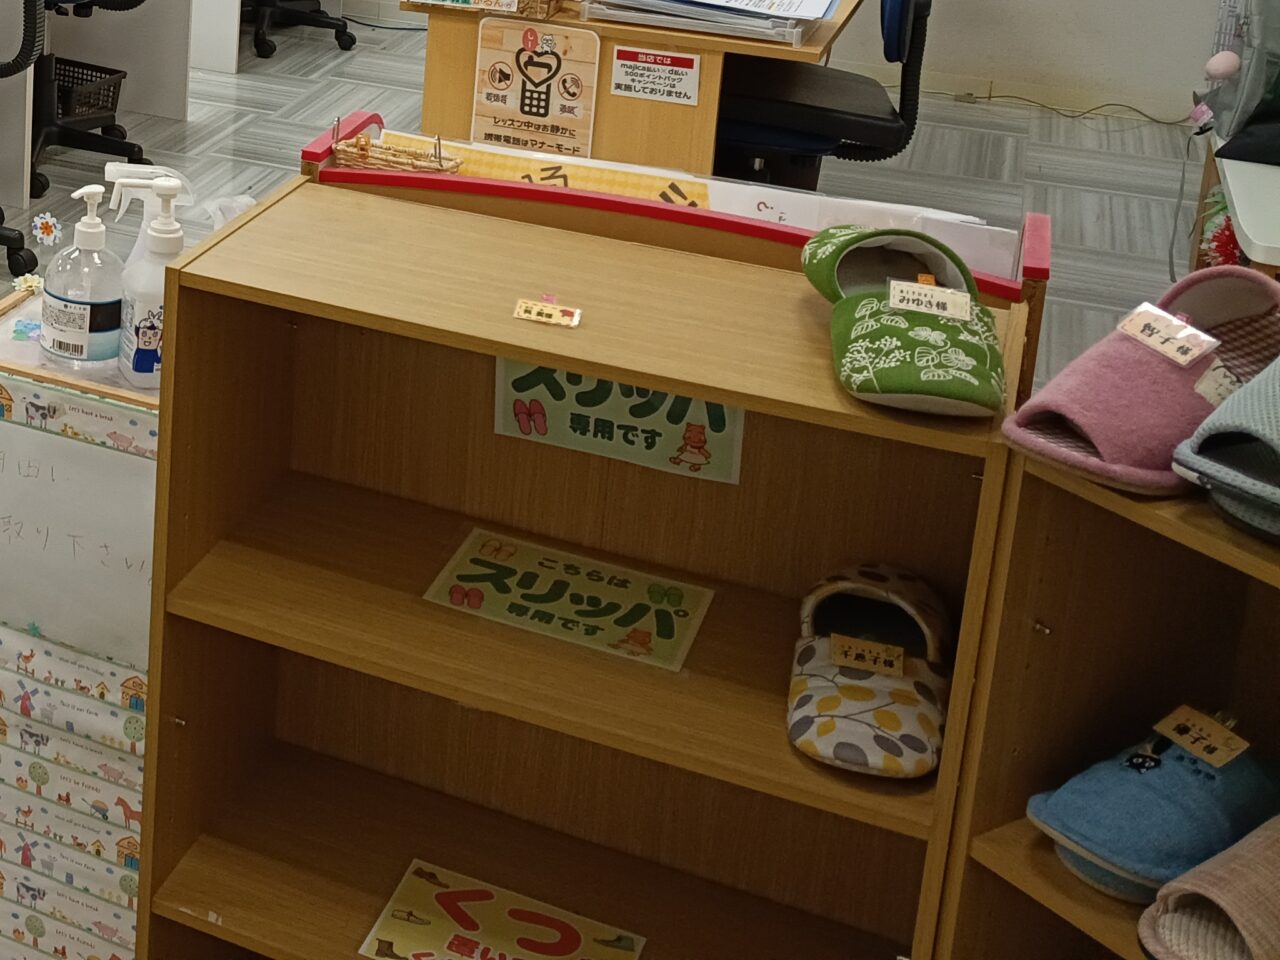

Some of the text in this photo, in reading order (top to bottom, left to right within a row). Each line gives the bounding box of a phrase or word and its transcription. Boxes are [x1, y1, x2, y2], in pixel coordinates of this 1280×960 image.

[637, 52, 672, 65] 当店では
[614, 82, 692, 100] 実施しておりません
[493, 116, 577, 137] レッスン中はお静かに
[484, 133, 581, 154] 携帯電話はマナーモード
[898, 297, 947, 312] みゆき様
[569, 413, 662, 450] 専用です
[537, 557, 632, 589] こちらは
[456, 557, 689, 640] スリッパ
[506, 601, 604, 636] 専用です
[434, 888, 582, 957] くつ
